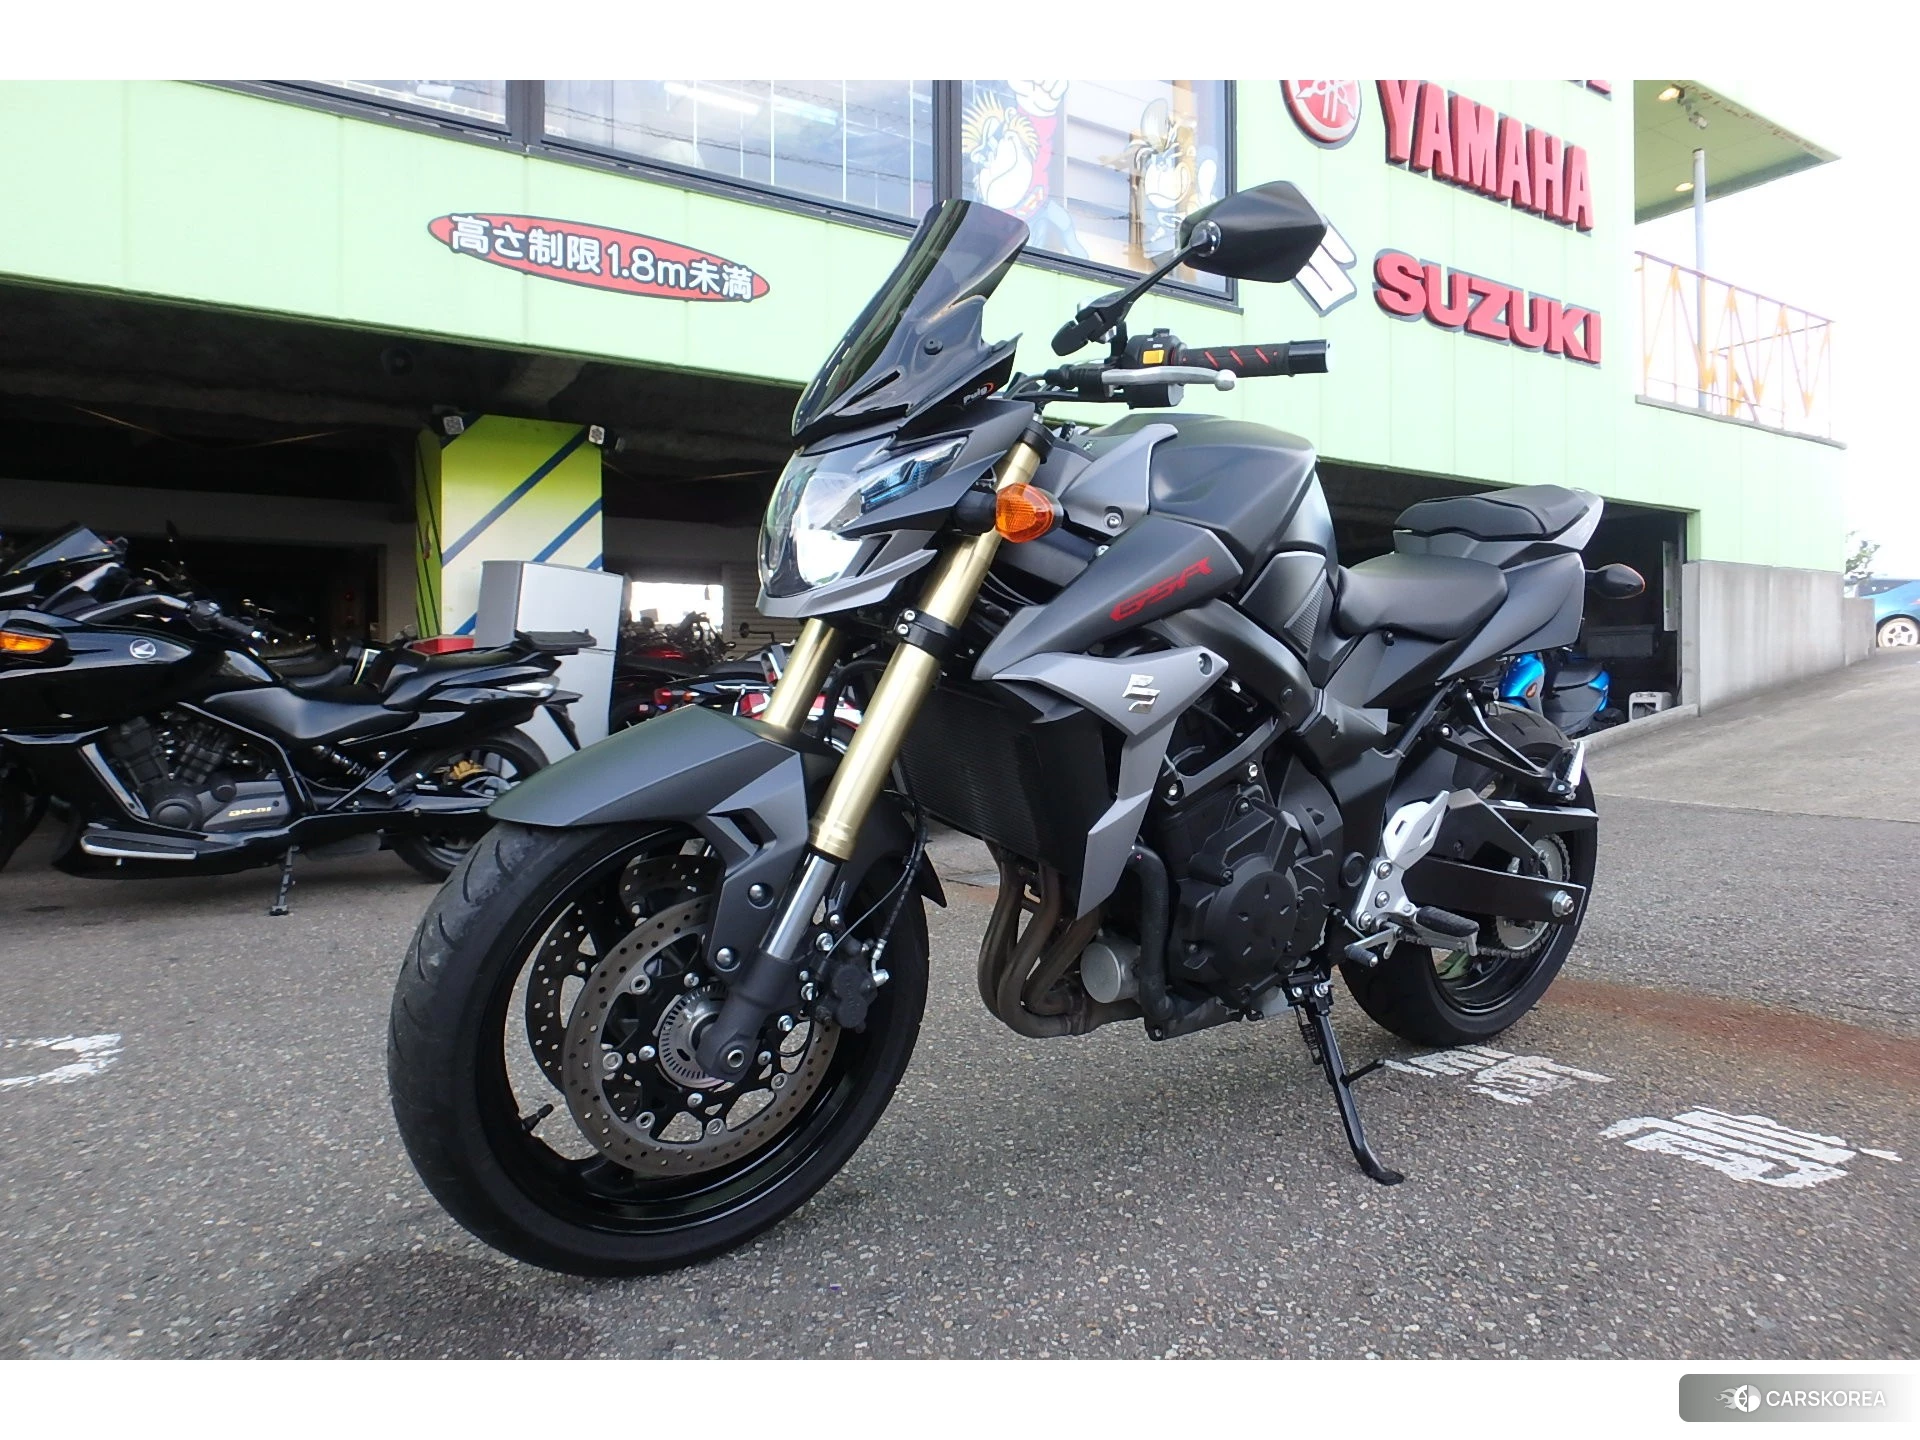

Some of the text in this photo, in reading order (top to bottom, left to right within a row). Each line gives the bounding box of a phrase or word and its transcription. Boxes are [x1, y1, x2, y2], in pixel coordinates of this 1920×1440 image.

[1376, 80, 1594, 232] YAMAHA
[451, 215, 753, 300] 高さ制限1.8m未満
[1374, 251, 1602, 364] SUZUKI
[1110, 556, 1213, 622] GSR
